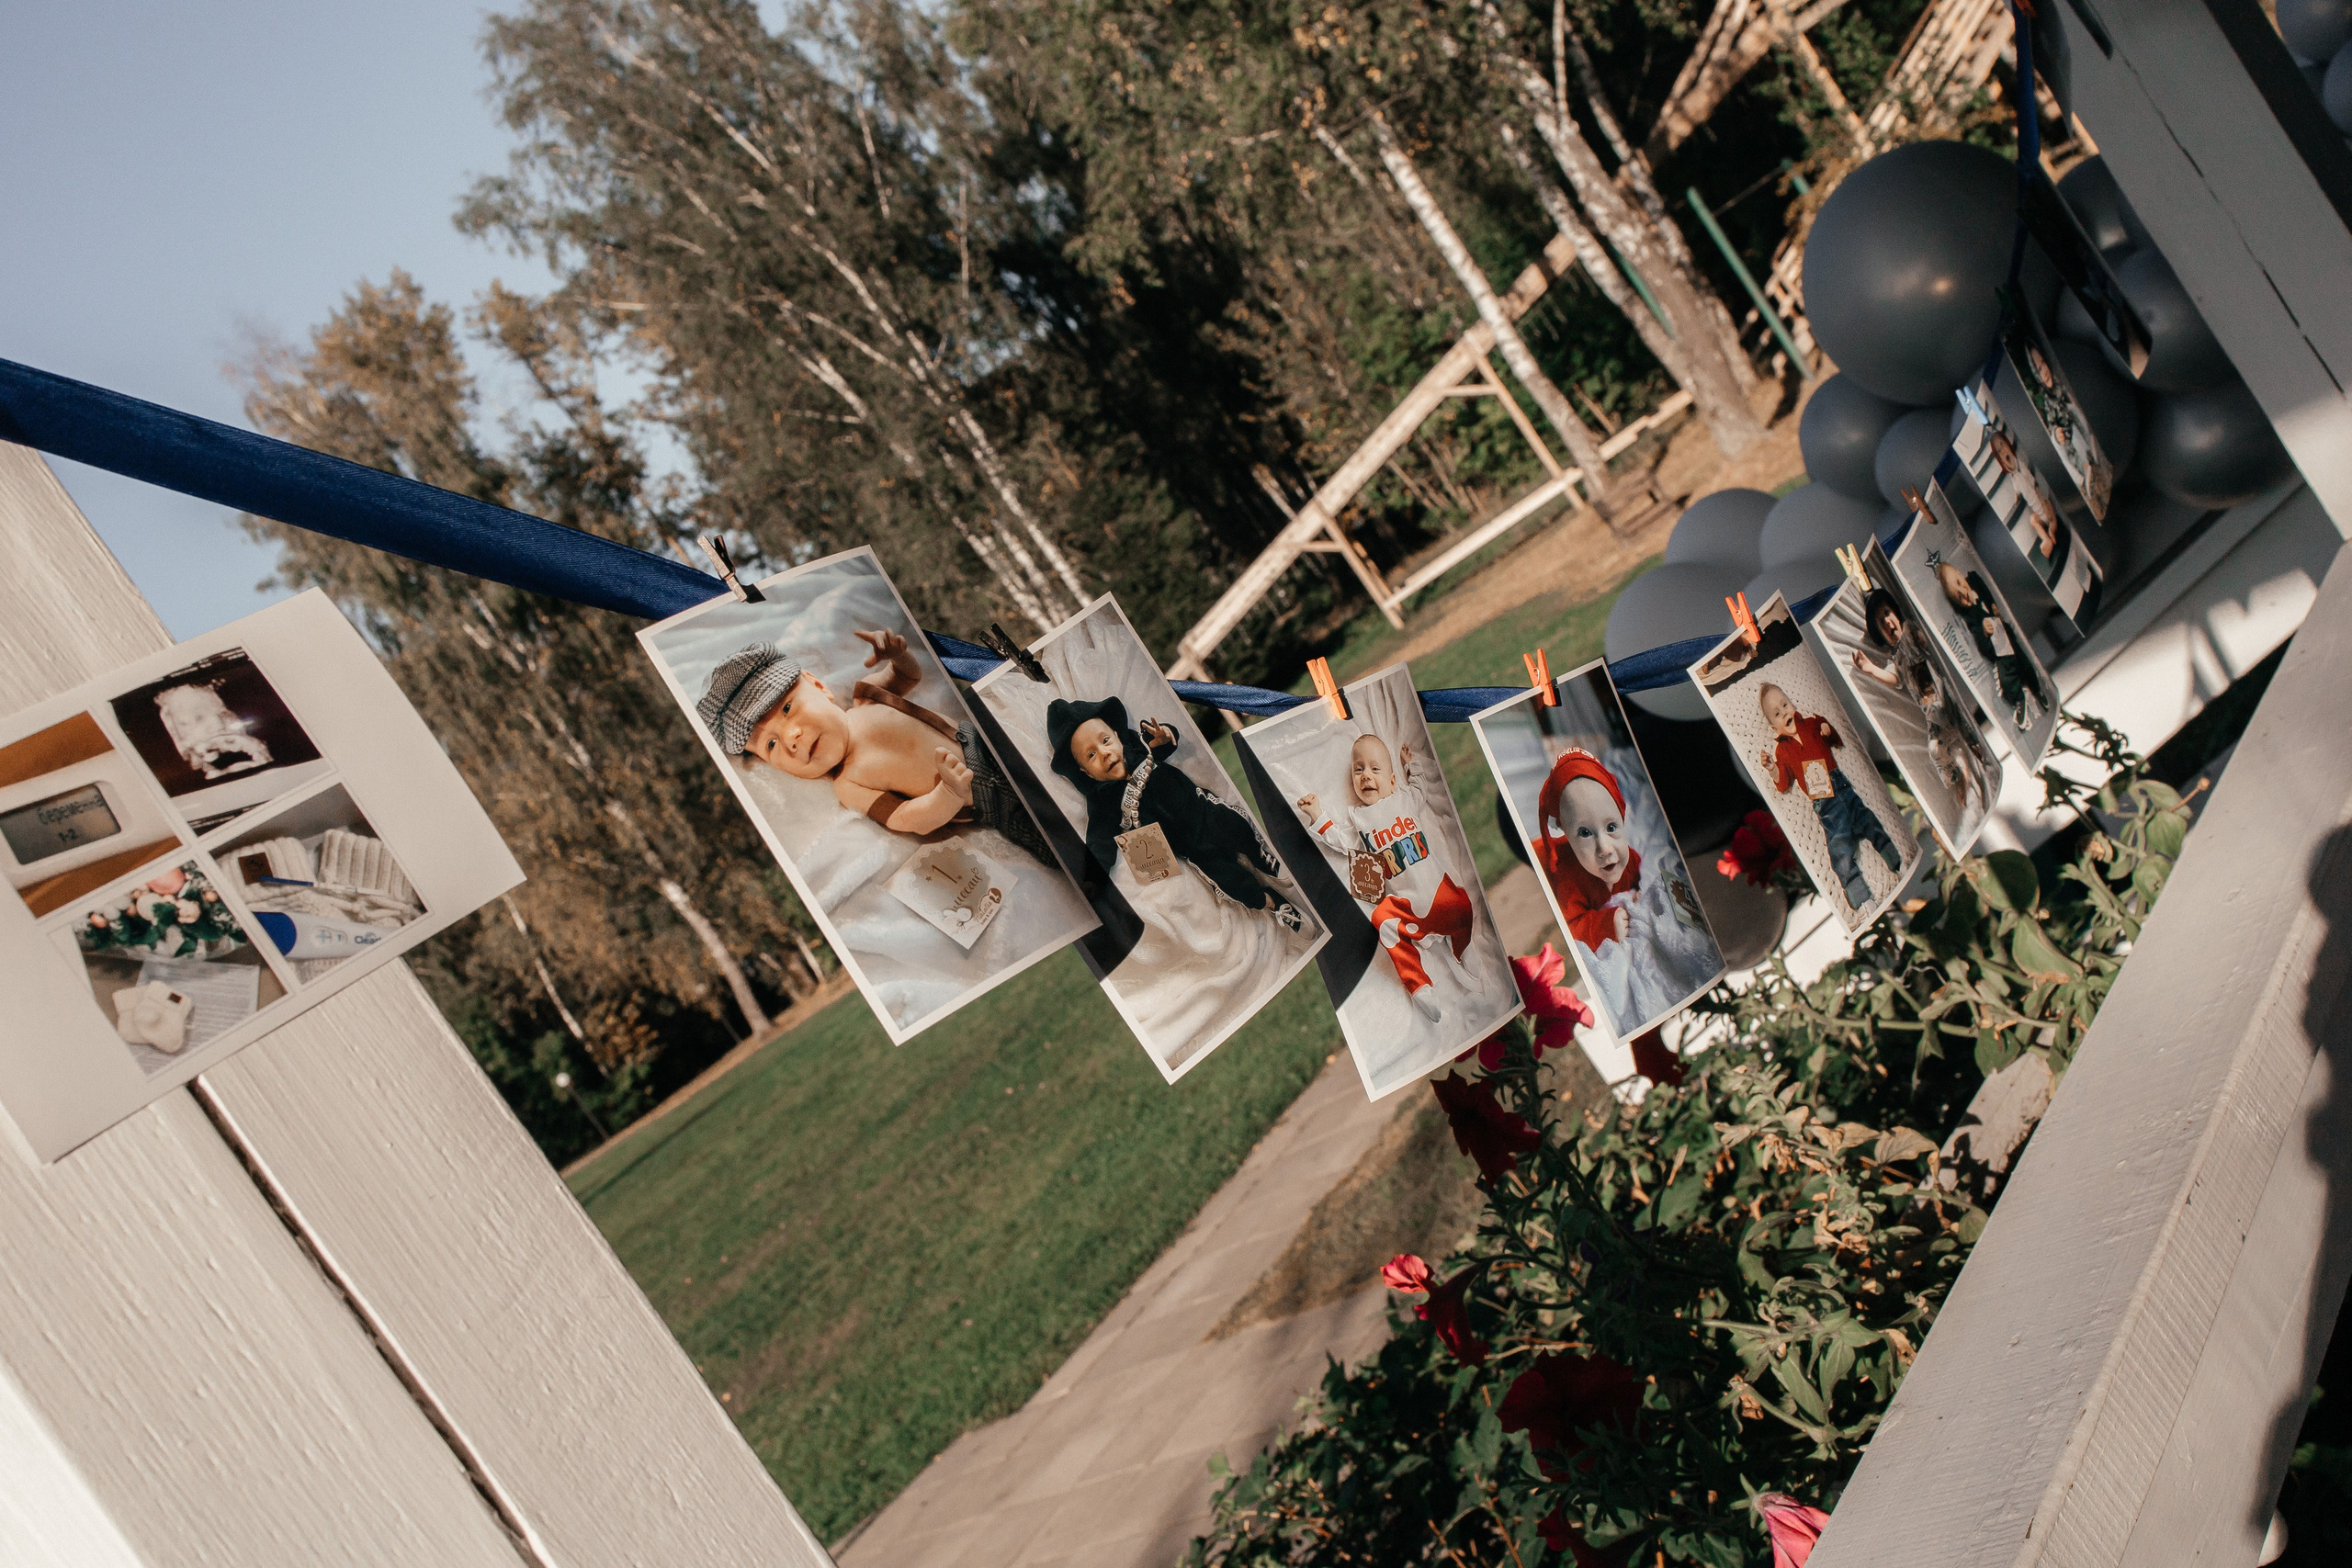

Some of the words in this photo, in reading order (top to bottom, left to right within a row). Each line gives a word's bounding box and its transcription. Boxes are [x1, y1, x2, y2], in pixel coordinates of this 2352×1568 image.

[1359, 817, 1418, 852] kinde
[1139, 839, 1154, 860] 2
[931, 864, 958, 885] 1
[1363, 863, 1372, 883] 3
